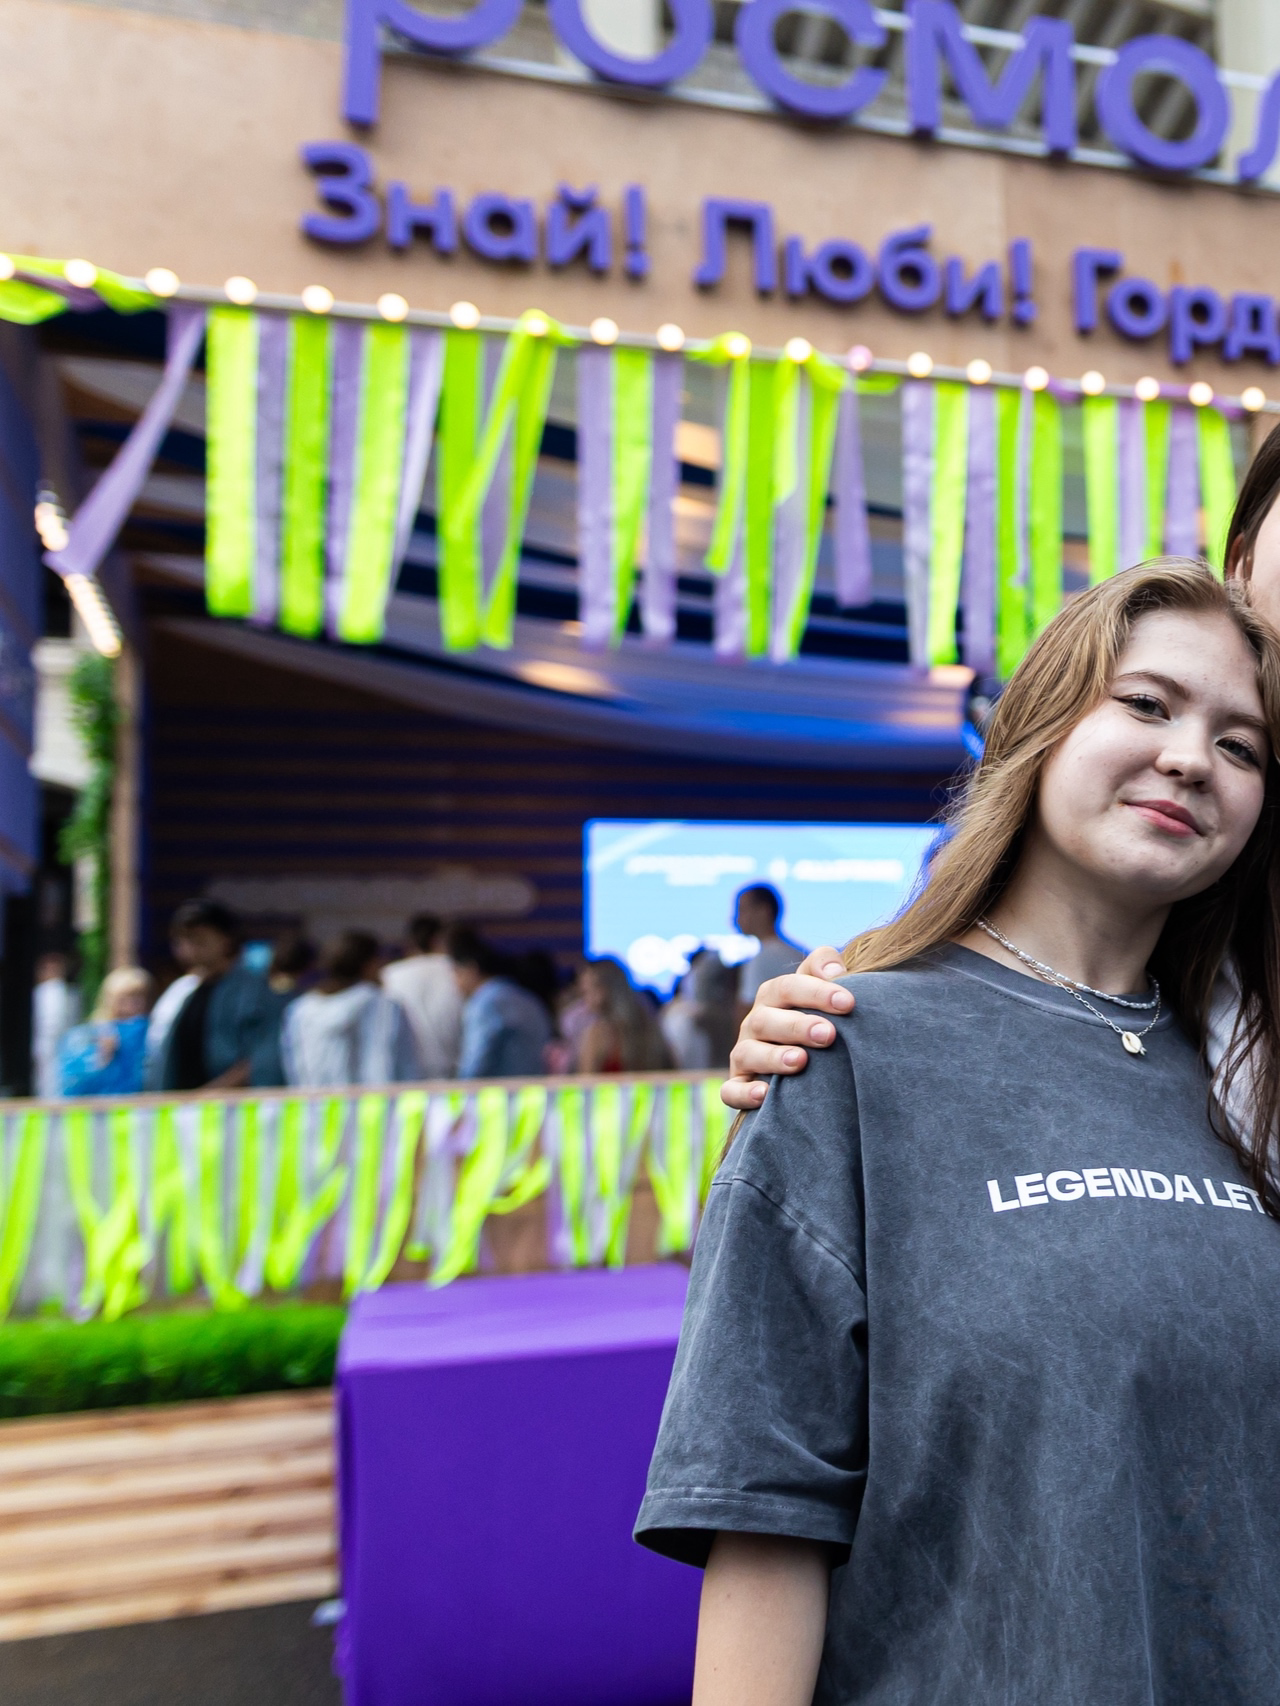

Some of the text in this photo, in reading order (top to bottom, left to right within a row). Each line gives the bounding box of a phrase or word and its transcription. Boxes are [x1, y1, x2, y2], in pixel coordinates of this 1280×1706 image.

[302, 142, 650, 278] Знай!
[693, 200, 1036, 325] Люби!
[986, 1167, 1204, 1212] LEGENDA
